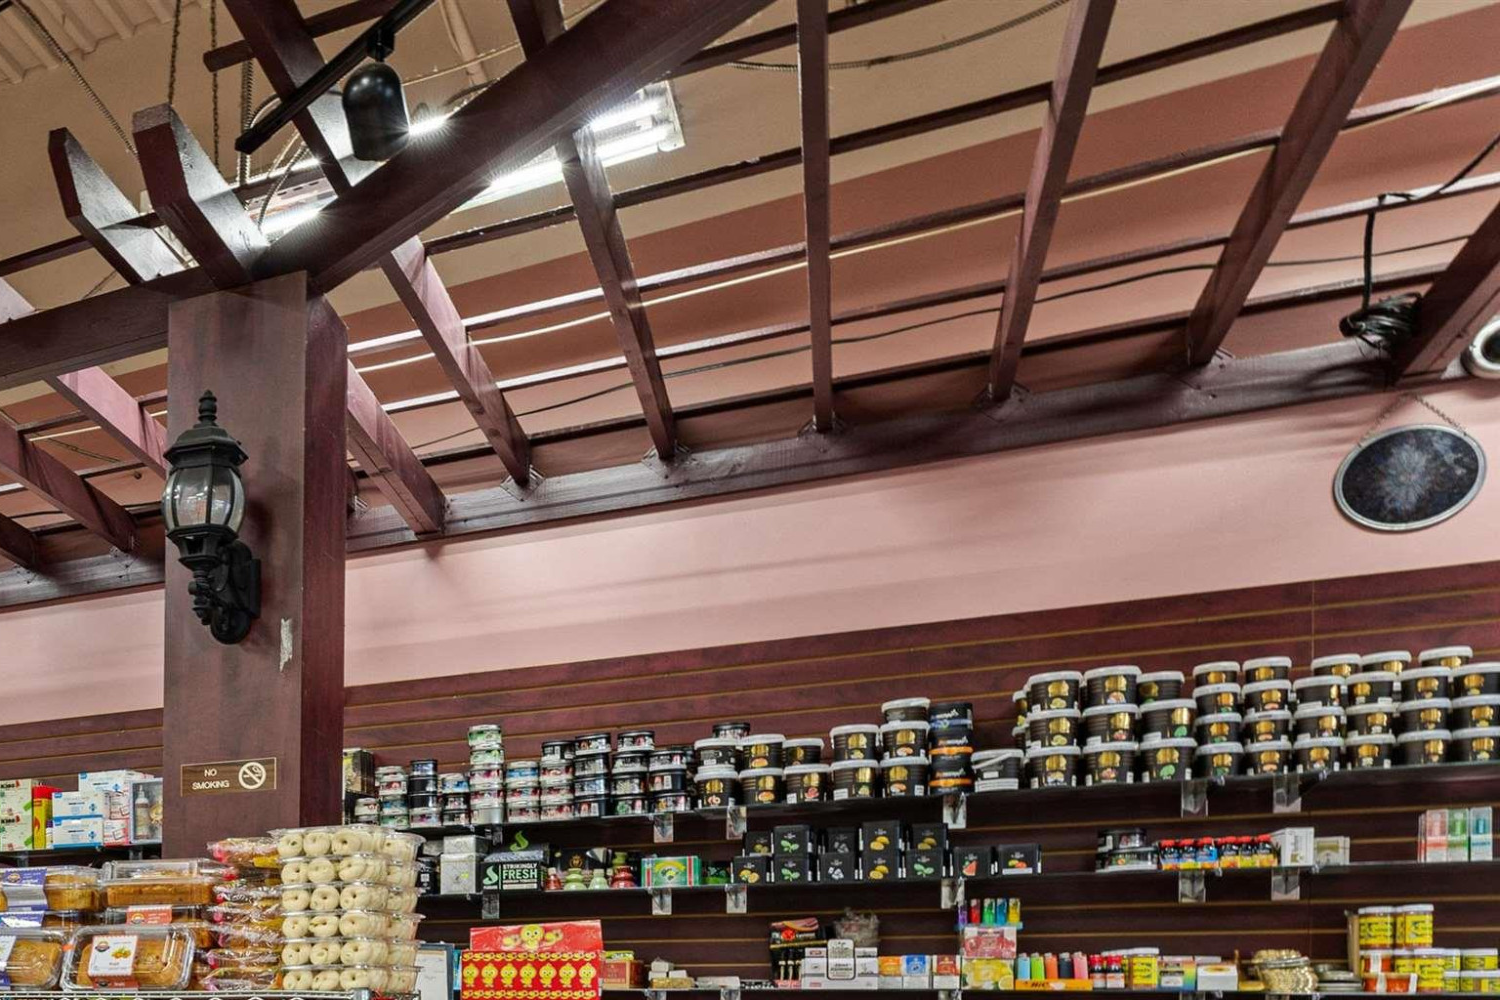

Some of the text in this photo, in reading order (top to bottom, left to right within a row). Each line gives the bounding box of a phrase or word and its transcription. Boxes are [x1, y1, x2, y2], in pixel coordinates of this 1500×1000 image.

[204, 768, 218, 777] NO
[192, 780, 230, 790] SMOKING
[503, 869, 538, 879] FRESH
